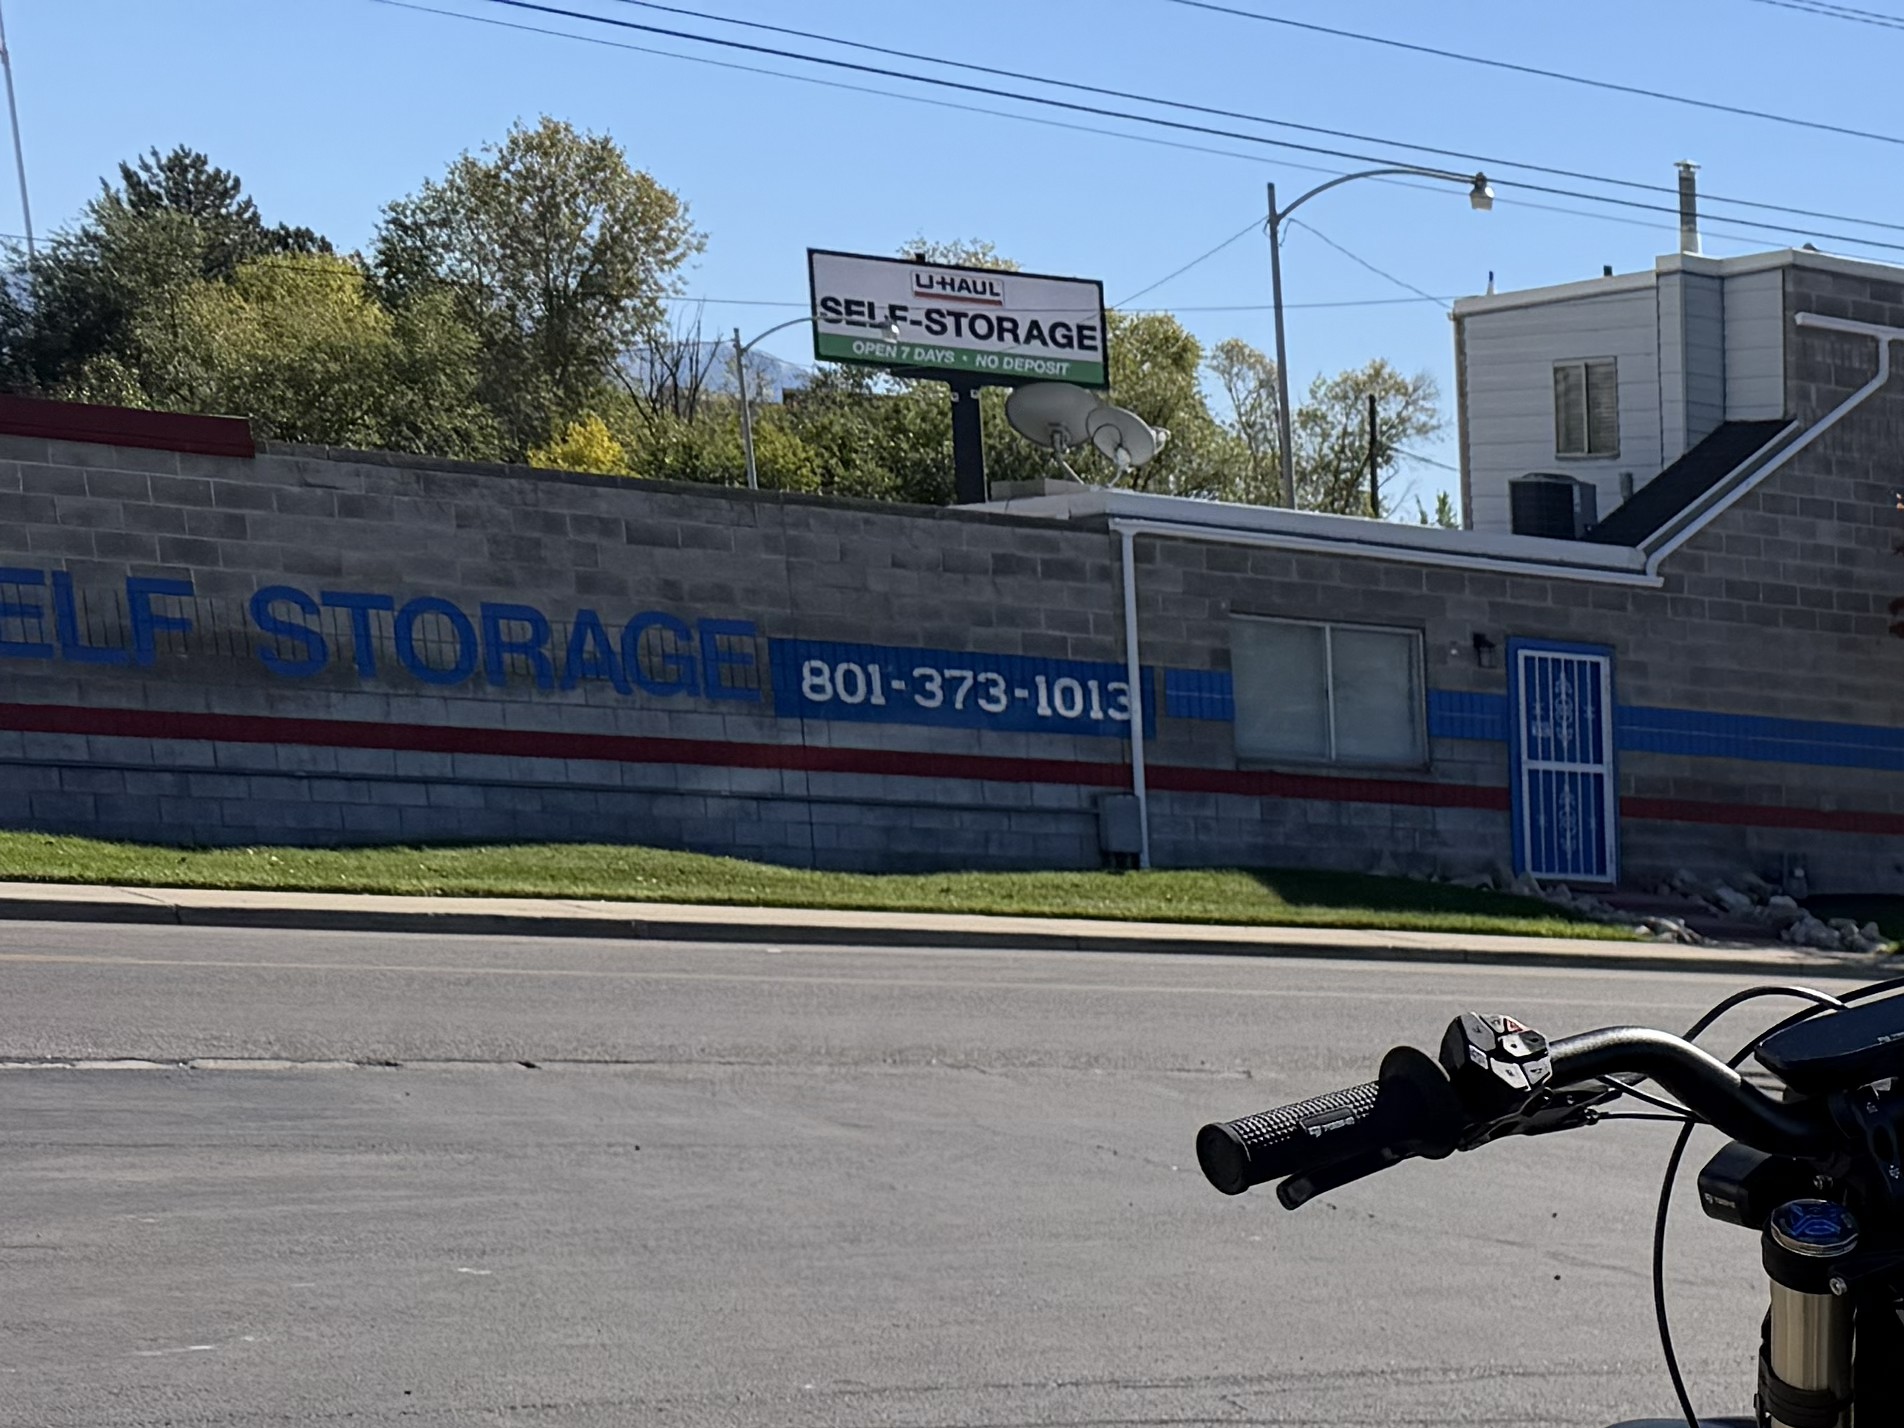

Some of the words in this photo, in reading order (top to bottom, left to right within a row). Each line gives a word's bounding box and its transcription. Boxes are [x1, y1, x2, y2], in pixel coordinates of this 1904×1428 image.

[915, 274, 1001, 297] U-HAUL
[820, 296, 1099, 351] SELF-STORAGE
[852, 341, 897, 359] OPEN
[900, 347, 911, 360] 7
[914, 347, 955, 363] DAYS
[976, 354, 998, 369] NO
[1003, 356, 1070, 375] DEPOSIT
[249, 585, 762, 698] STORAGE
[802, 660, 1132, 721] 801-373-1013
